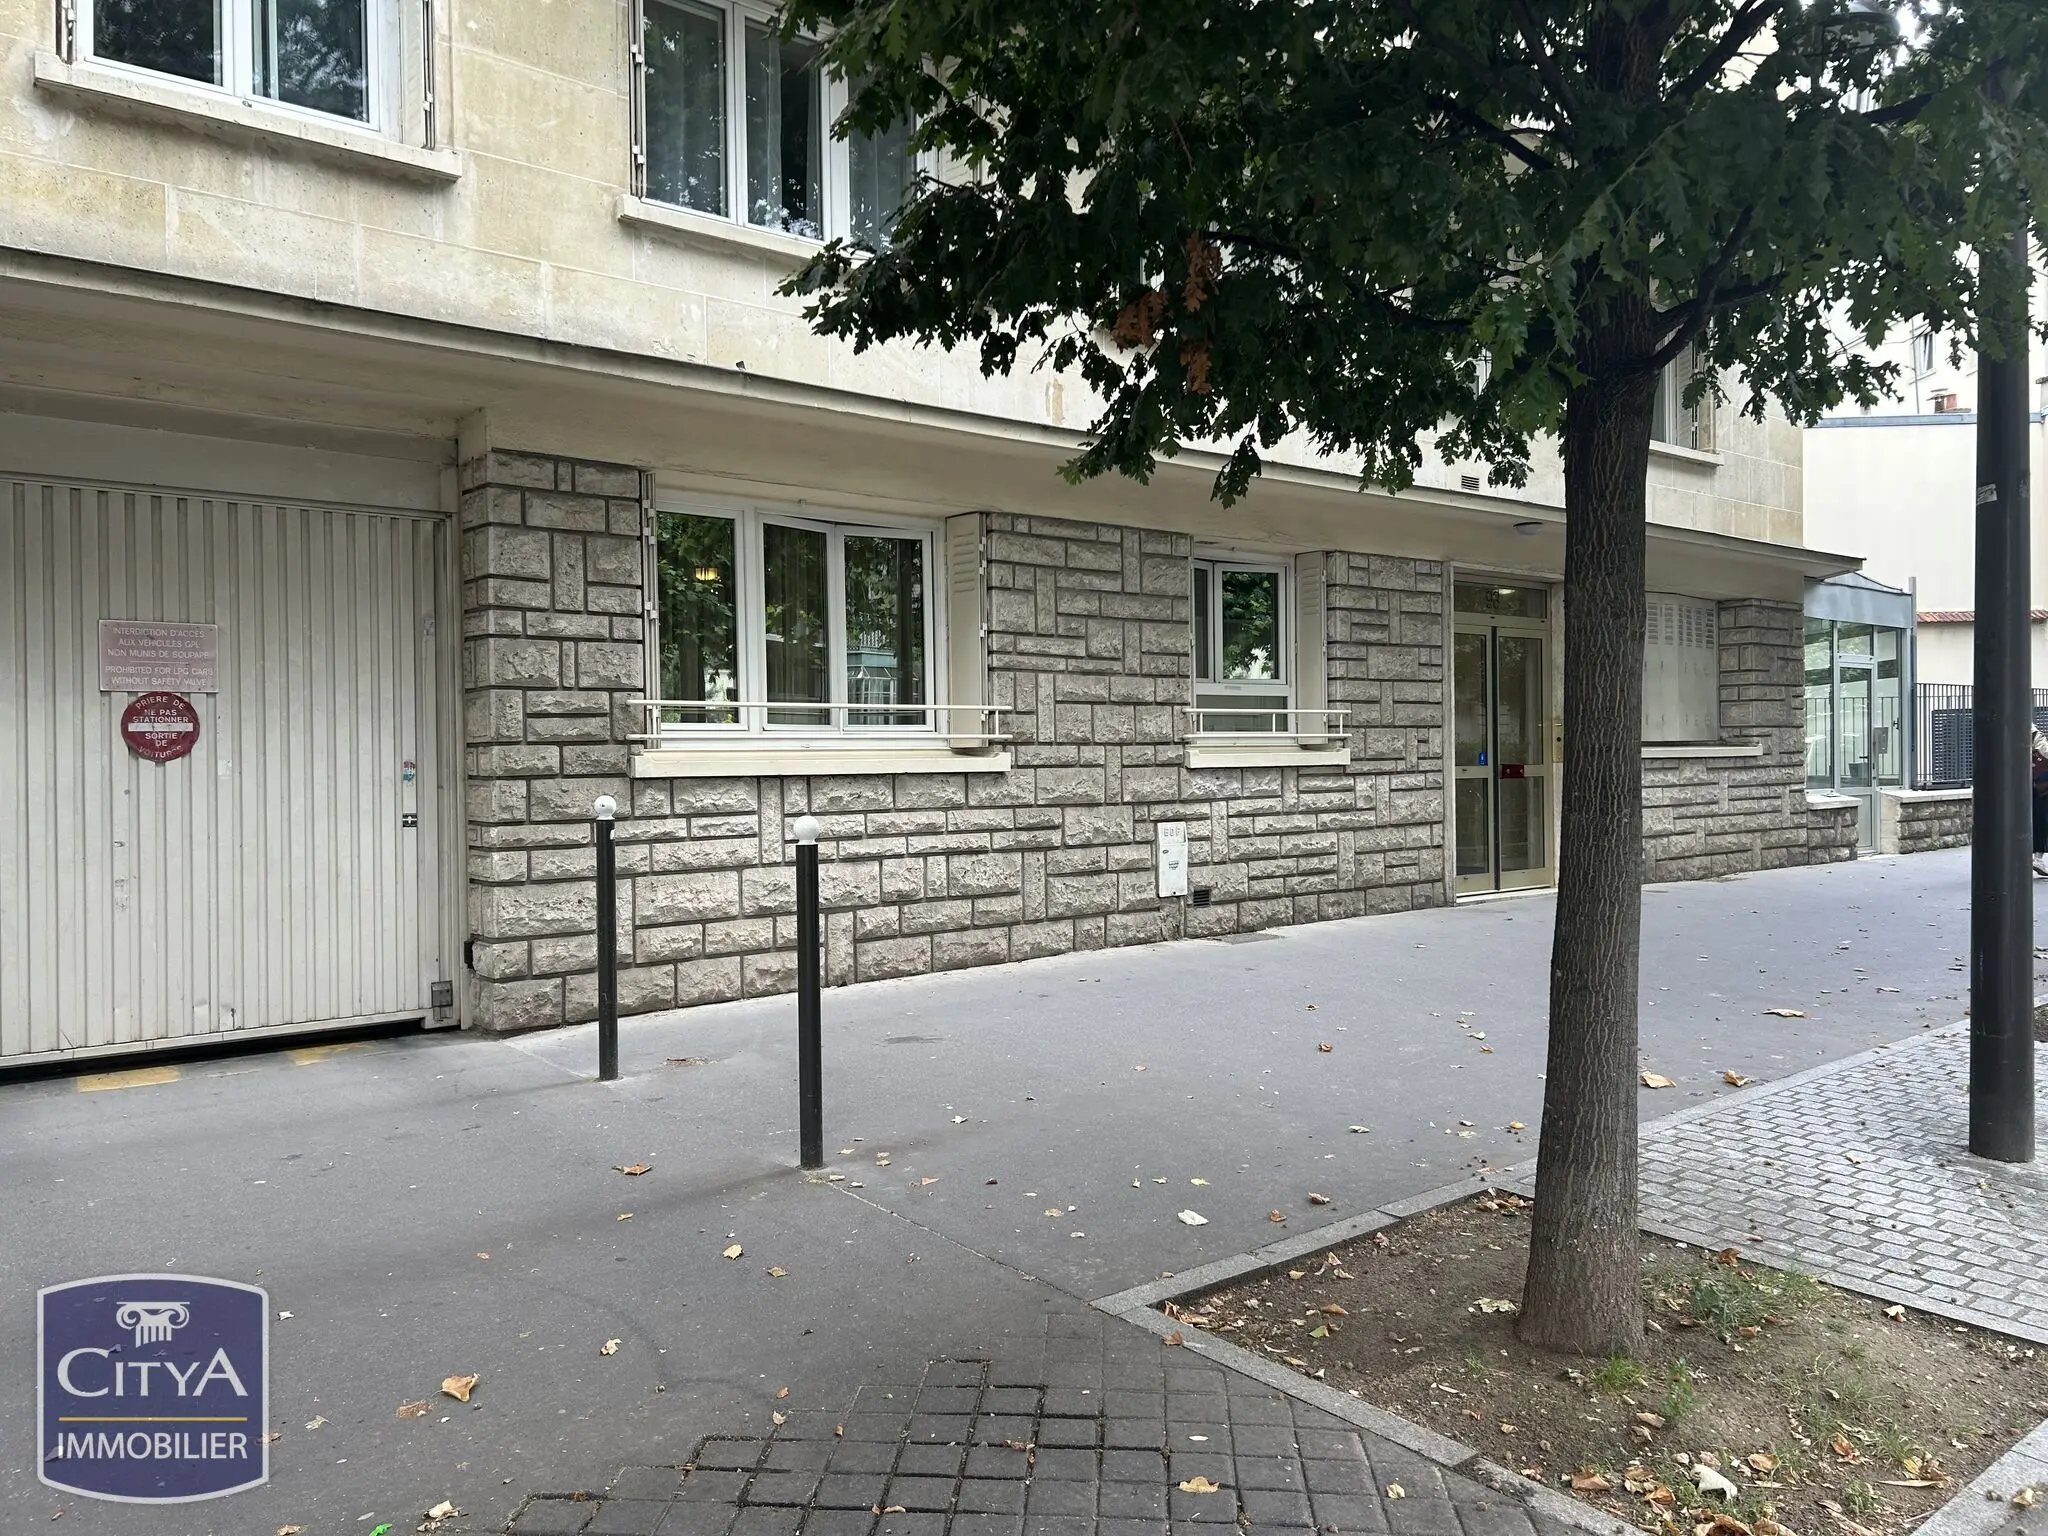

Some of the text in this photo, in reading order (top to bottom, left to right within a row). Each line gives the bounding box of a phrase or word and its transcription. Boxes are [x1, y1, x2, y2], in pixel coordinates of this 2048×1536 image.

[113, 627, 168, 637] INTERDICTION
[119, 638, 136, 646] AUX
[185, 640, 200, 648] GPL
[107, 648, 210, 659] NON MUNIS DE SOUPAPE
[105, 665, 214, 676] PROHIBITED FOR LPG CARS
[111, 676, 208, 686] WITHOUT SAFETY VALVE
[172, 699, 186, 710] DE
[145, 732, 178, 740] SORTIE
